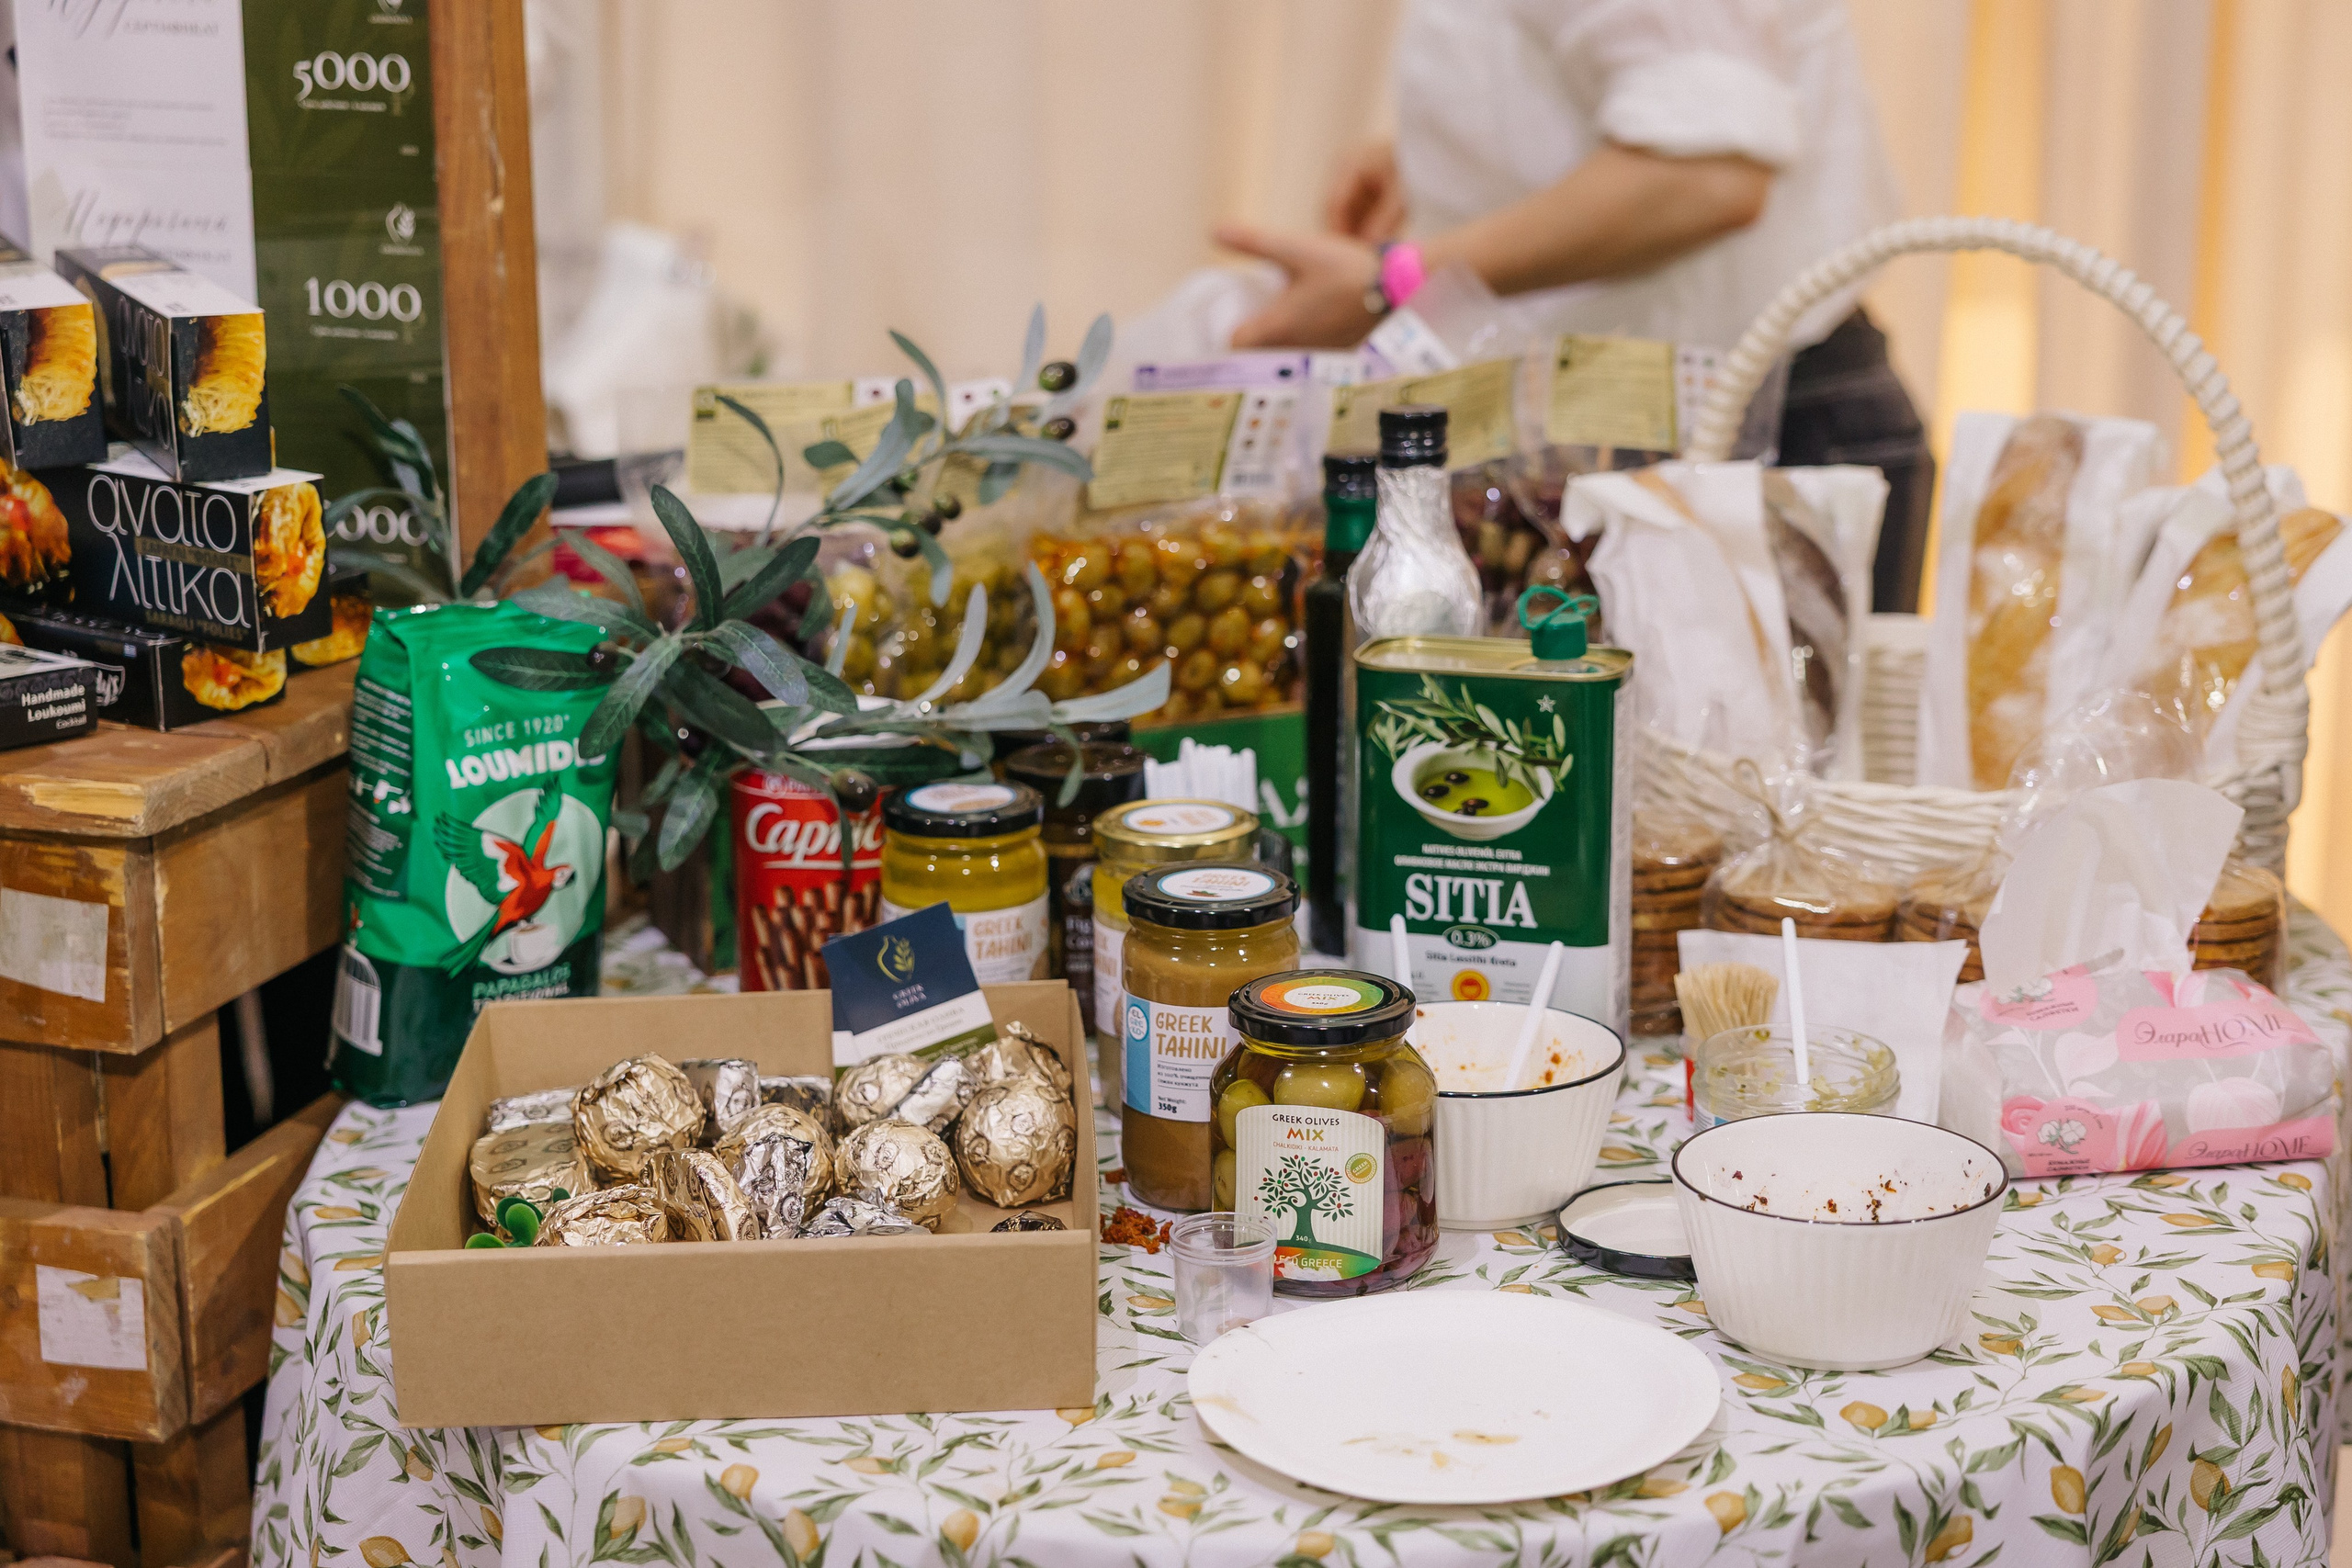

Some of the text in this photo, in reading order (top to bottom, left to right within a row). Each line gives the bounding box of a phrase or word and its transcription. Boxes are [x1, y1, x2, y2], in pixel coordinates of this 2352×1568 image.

[293, 51, 412, 101] 5000
[304, 276, 423, 322] 1000
[325, 503, 429, 547] 000
[21, 682, 85, 707] Handmade
[27, 698, 86, 723] Loukoumi
[464, 721, 515, 748] SINCE
[1405, 873, 1539, 930] SITIA
[974, 918, 1023, 937] GREEK
[1451, 930, 1492, 948] 0.3%
[1156, 1012, 1213, 1033] GREEK
[1156, 1033, 1227, 1060] TAHINI
[1159, 1102, 1178, 1113] 350g
[1272, 1113, 1340, 1126] GREEK OLIVES
[1286, 1127, 1324, 1142] MIX
[1272, 1141, 1303, 1151] CHALKIDIKI
[1352, 1160, 1369, 1174] GREEK
[1301, 1258, 1342, 1269] GREECE
